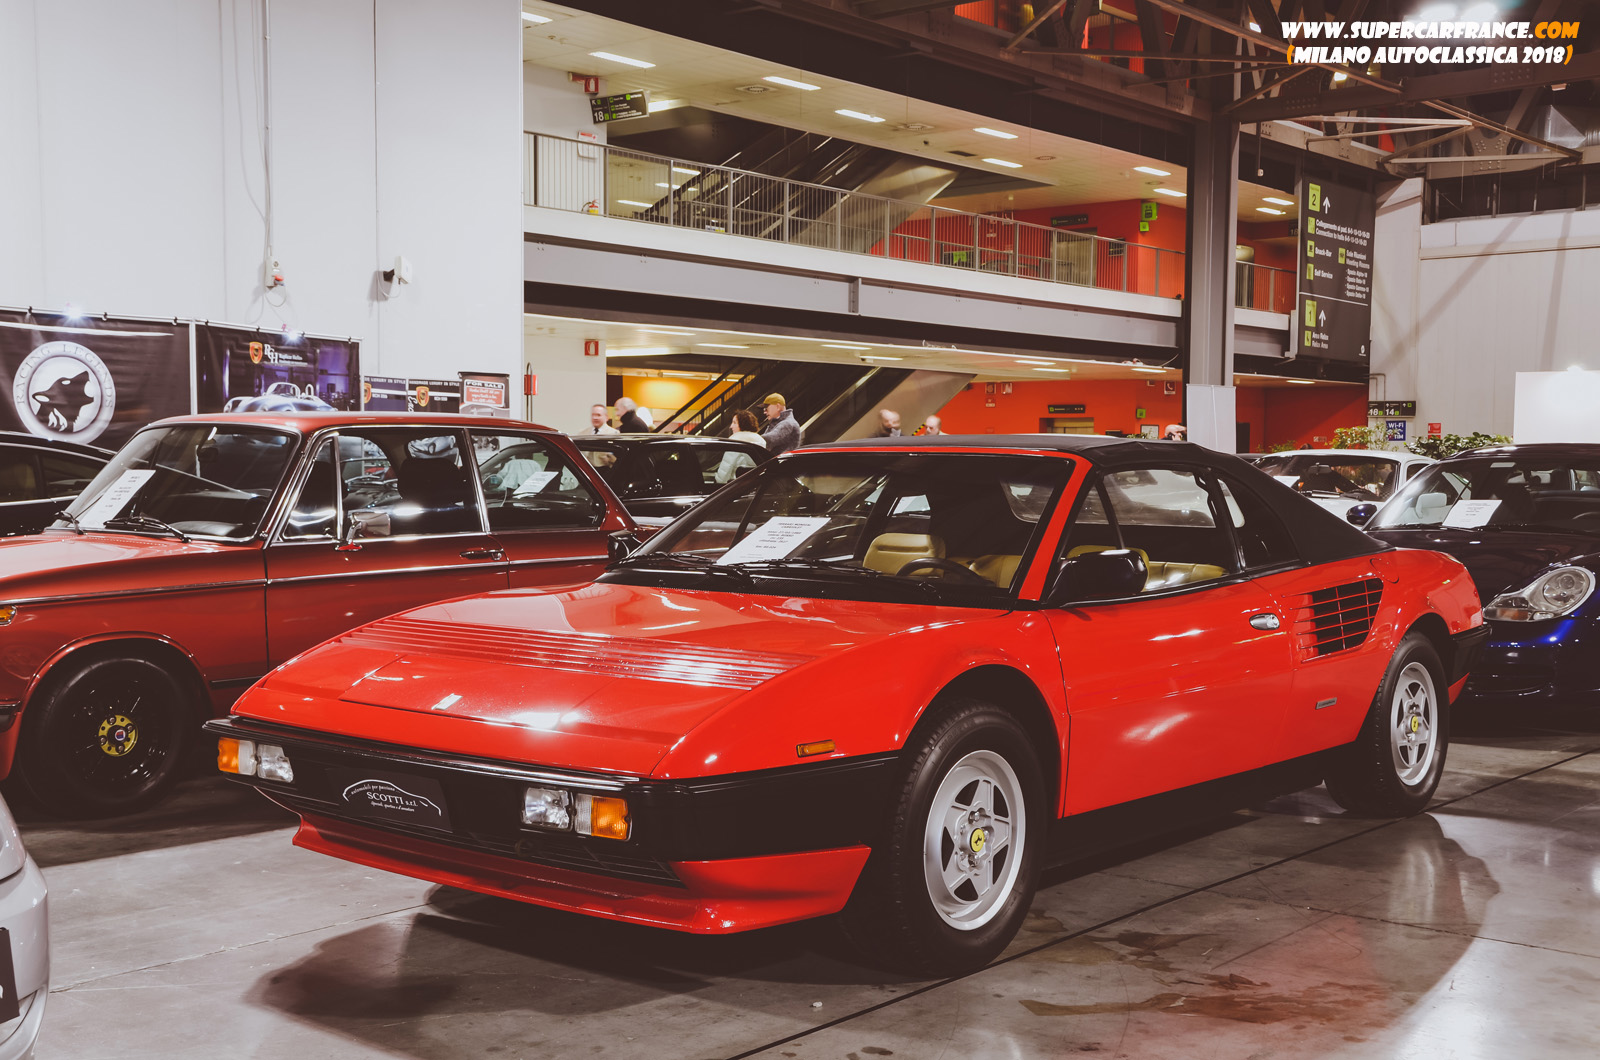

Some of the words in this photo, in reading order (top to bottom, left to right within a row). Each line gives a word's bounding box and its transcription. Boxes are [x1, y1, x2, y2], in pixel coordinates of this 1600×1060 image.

[594, 111, 604, 122] 18
[1312, 193, 1316, 206] 2
[1321, 271, 1333, 279] Service
[16, 346, 50, 404] RACING
[63, 344, 112, 408] LEGENDS
[367, 792, 404, 804] SCOTTI
